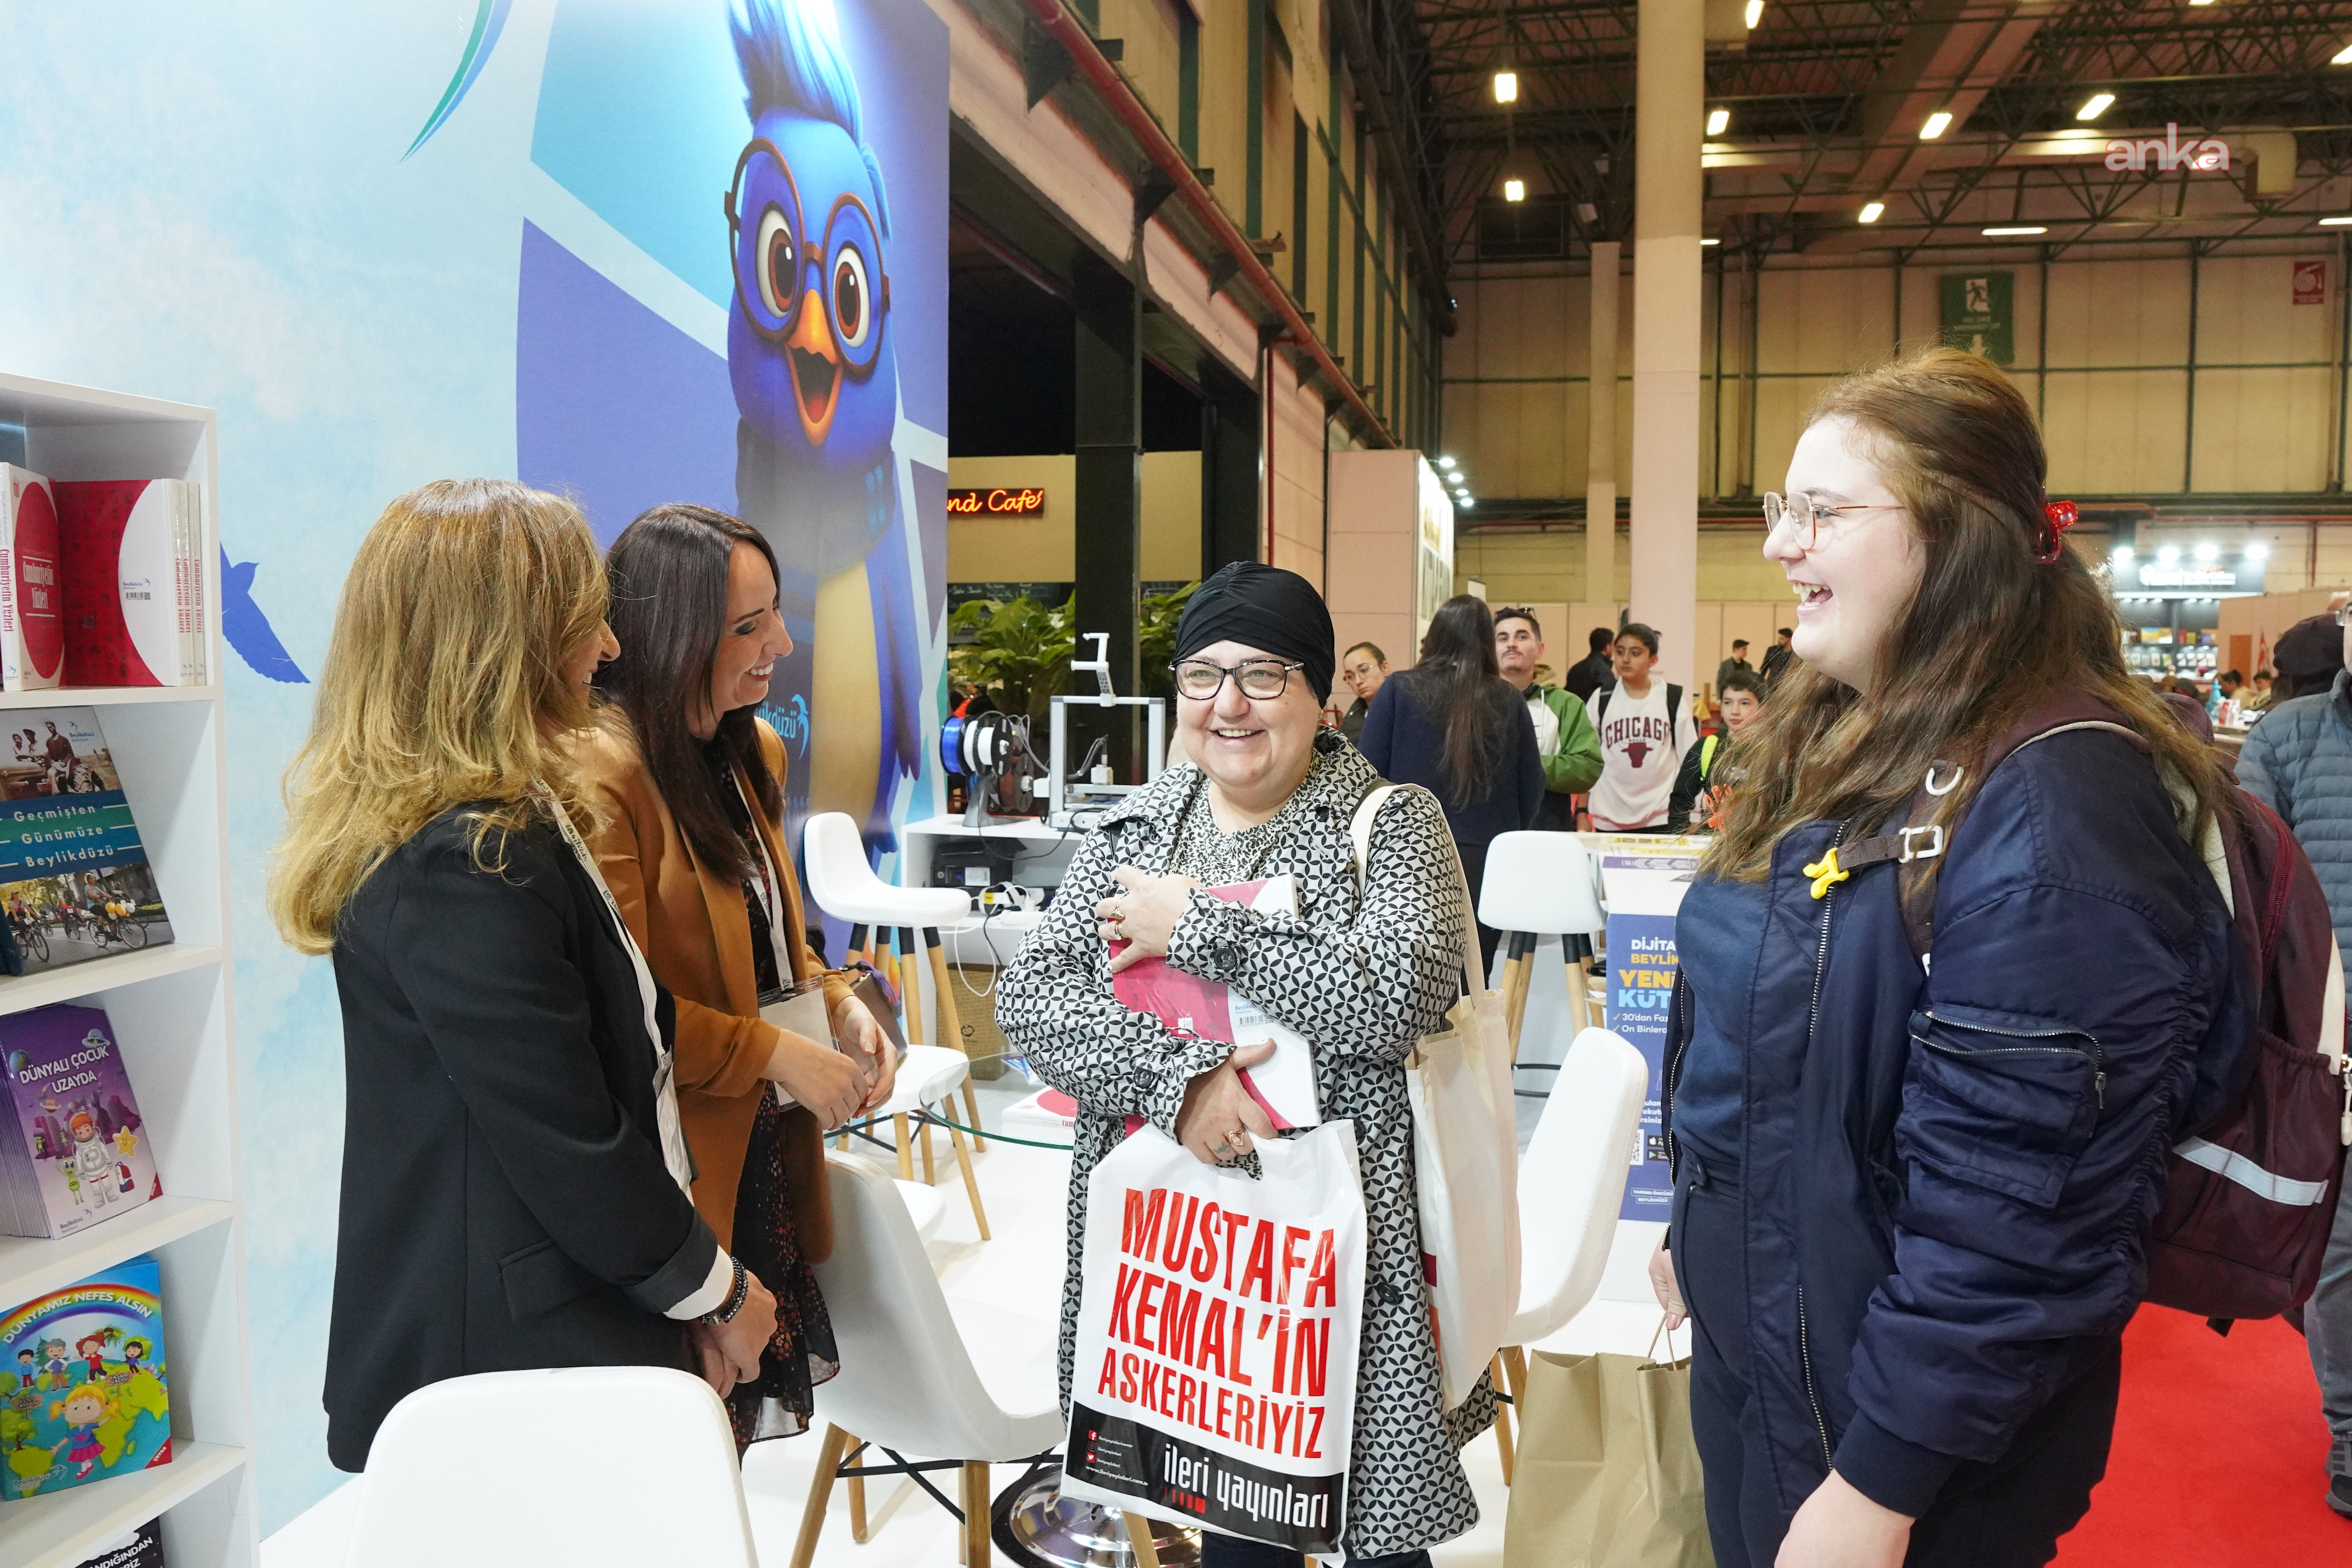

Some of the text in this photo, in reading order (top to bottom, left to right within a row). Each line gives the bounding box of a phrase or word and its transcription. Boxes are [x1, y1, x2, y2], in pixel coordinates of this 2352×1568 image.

[947, 489, 1044, 513] nd Café
[3, 604, 14, 633] Yüzleri
[13, 806, 95, 822] Geçmişten
[21, 826, 103, 844] Günümüze
[25, 845, 114, 867] Beylikdüzü
[1631, 936, 1676, 951] DİJİTA
[1630, 951, 1679, 965] BEYLİK
[1618, 989, 1673, 1009] KÜT
[19, 1045, 109, 1084] DÜNYALI ÇOCUK
[51, 1070, 97, 1093] UZAYDA
[1062, 1119, 1074, 1128] Cum
[1122, 1189, 1335, 1307] MUSTAFA
[2, 1291, 153, 1344] DÜNYAMIZ NEFES ALSIN
[1109, 1263, 1329, 1396] KEMAL'İN
[1098, 1347, 1324, 1458] ASKERLERİYİZ
[1164, 1444, 1328, 1529] ileri yayınları
